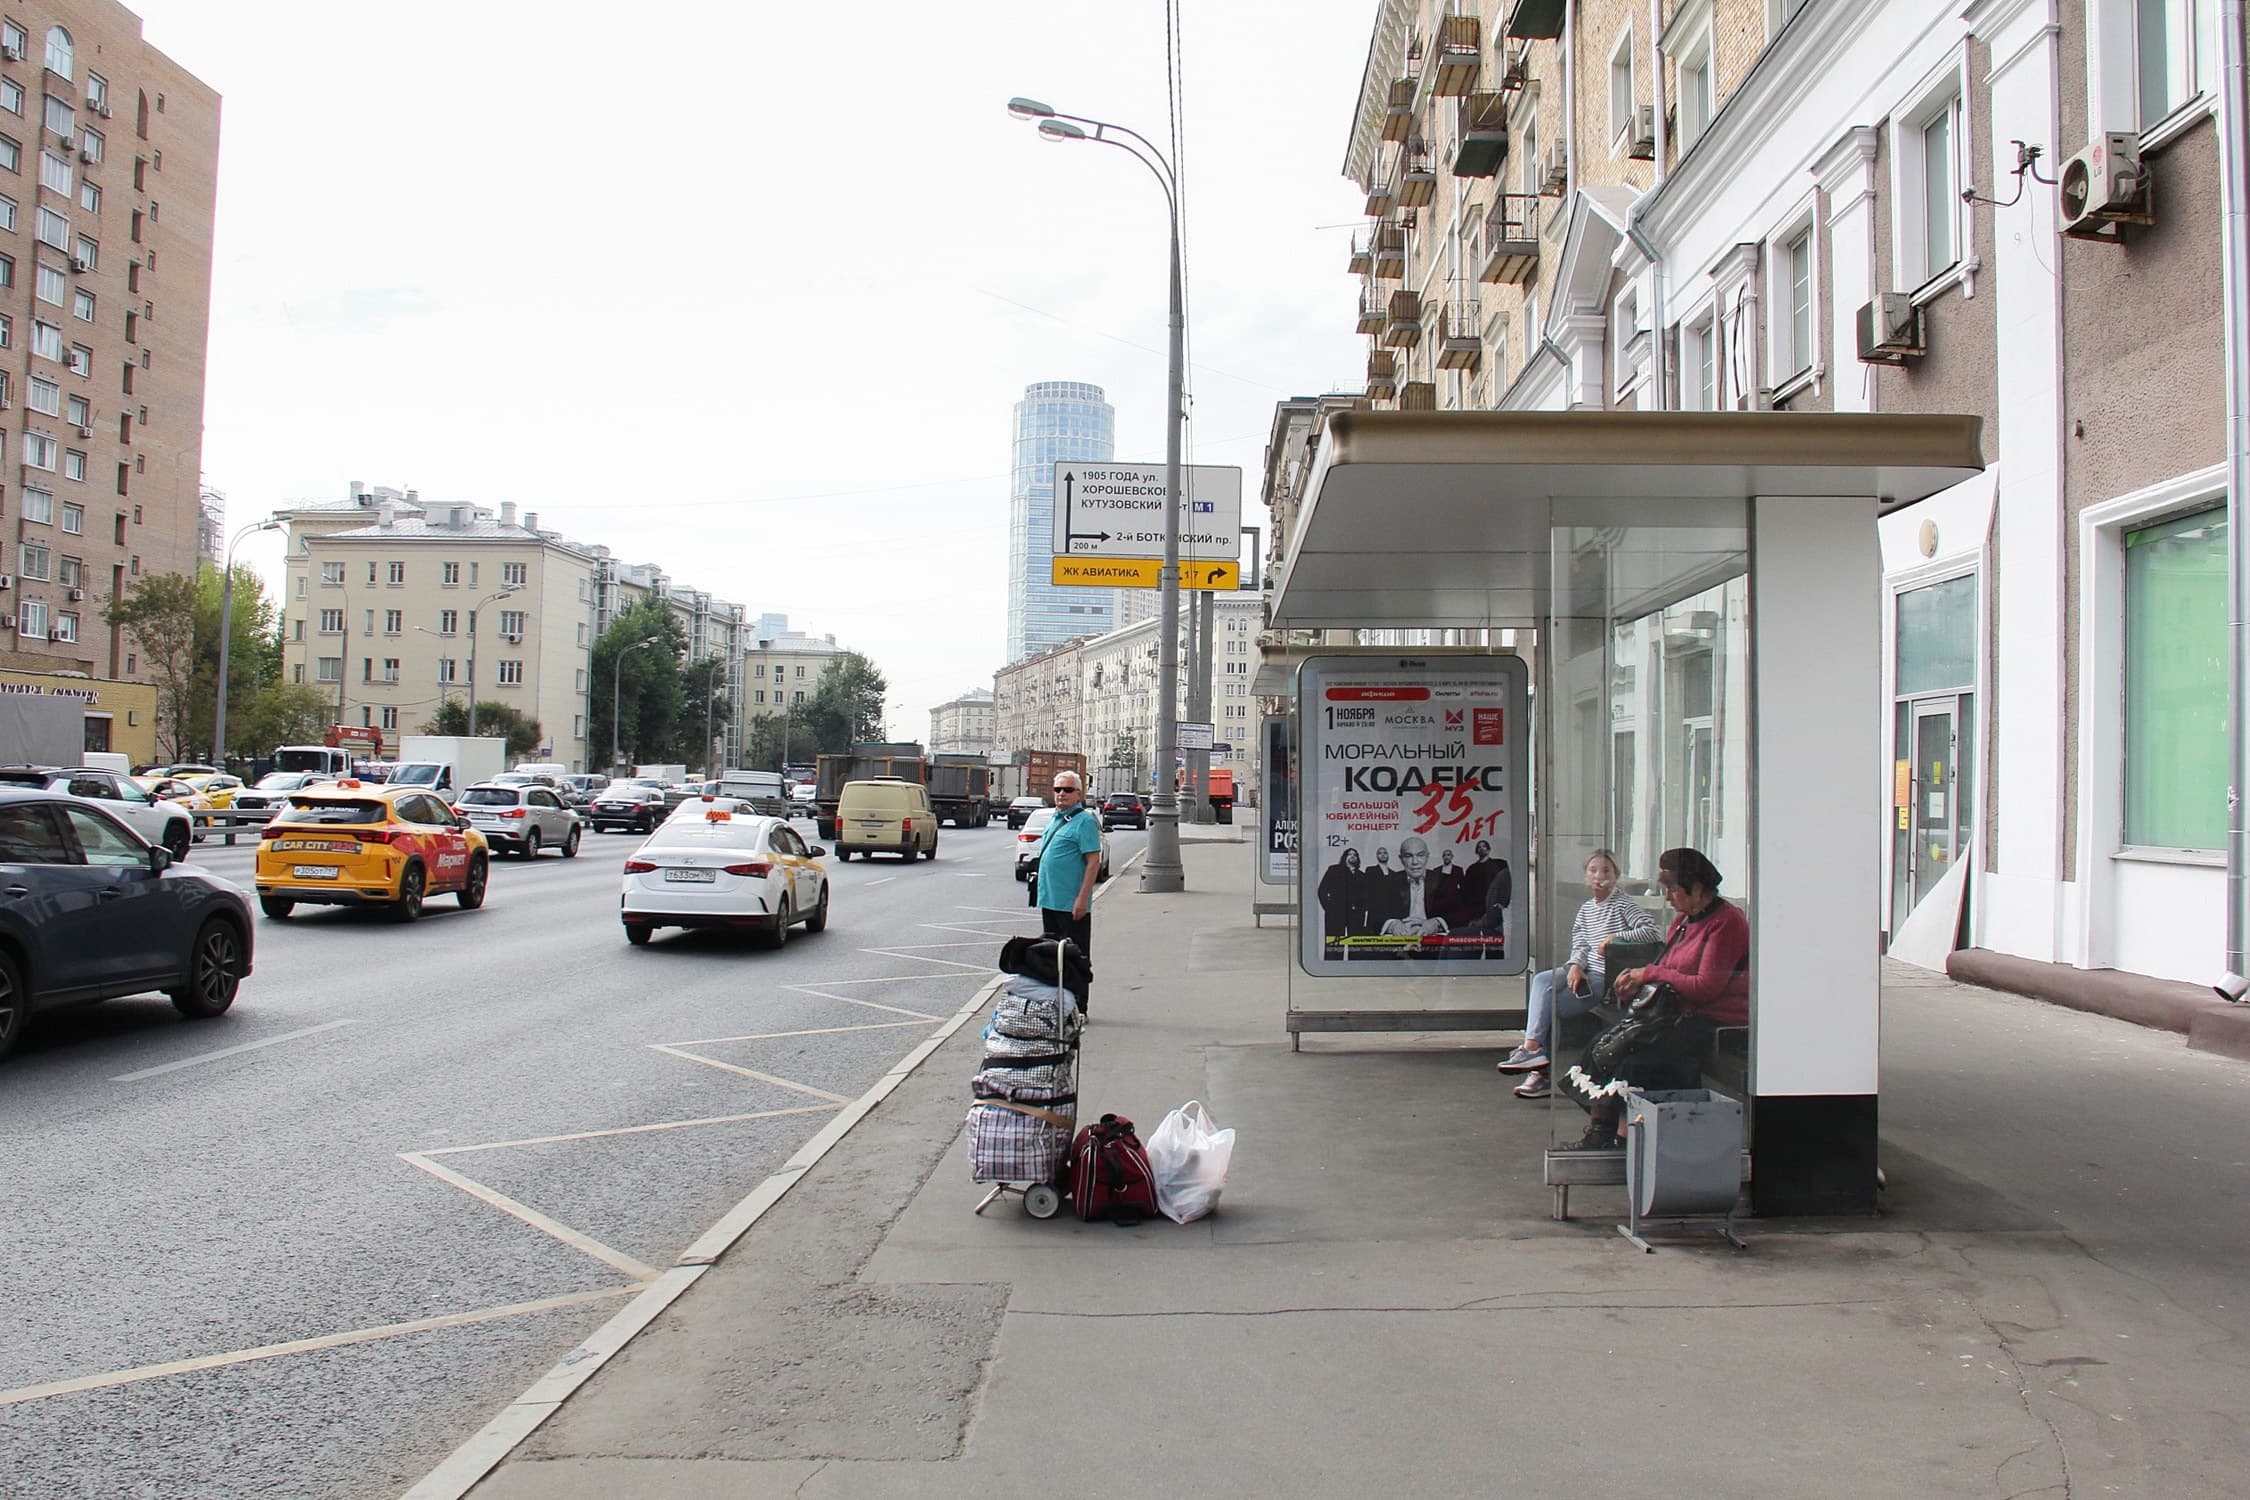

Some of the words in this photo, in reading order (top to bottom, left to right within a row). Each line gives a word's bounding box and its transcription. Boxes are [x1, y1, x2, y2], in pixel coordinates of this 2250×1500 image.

[1082, 471, 1107, 481] 1905
[1109, 472, 1139, 483] ГОДА
[1142, 474, 1158, 483] ул.
[1081, 498, 1162, 511] КУТУЗОВСКИЙ
[1116, 531, 1133, 542] 2-й
[1136, 532, 1213, 544] БОТКСКИЙ
[1215, 536, 1232, 546] пр.
[1073, 542, 1089, 550] 200
[1063, 567, 1079, 576] ЖК
[1082, 567, 1140, 578] АВИАТИКА
[1325, 706, 1334, 730] 1
[1336, 707, 1375, 720] НОЯБРЯ
[1384, 715, 1436, 725] МОСКВА
[1325, 740, 1465, 759] МОРАЛЬНЫЙ
[1345, 766, 1503, 796] КОДЕКС
[1343, 800, 1399, 811] БОЛЬШОЙ
[1413, 778, 1480, 834] 35
[1326, 811, 1399, 821] ЮБИЛЕЙНЫЙ
[1347, 823, 1399, 833] КОНЦЕРТ
[1456, 810, 1505, 844] ЛЕТ
[283, 841, 303, 850] CAR
[1326, 835, 1350, 847] 12+
[437, 853, 466, 869] Маркет
